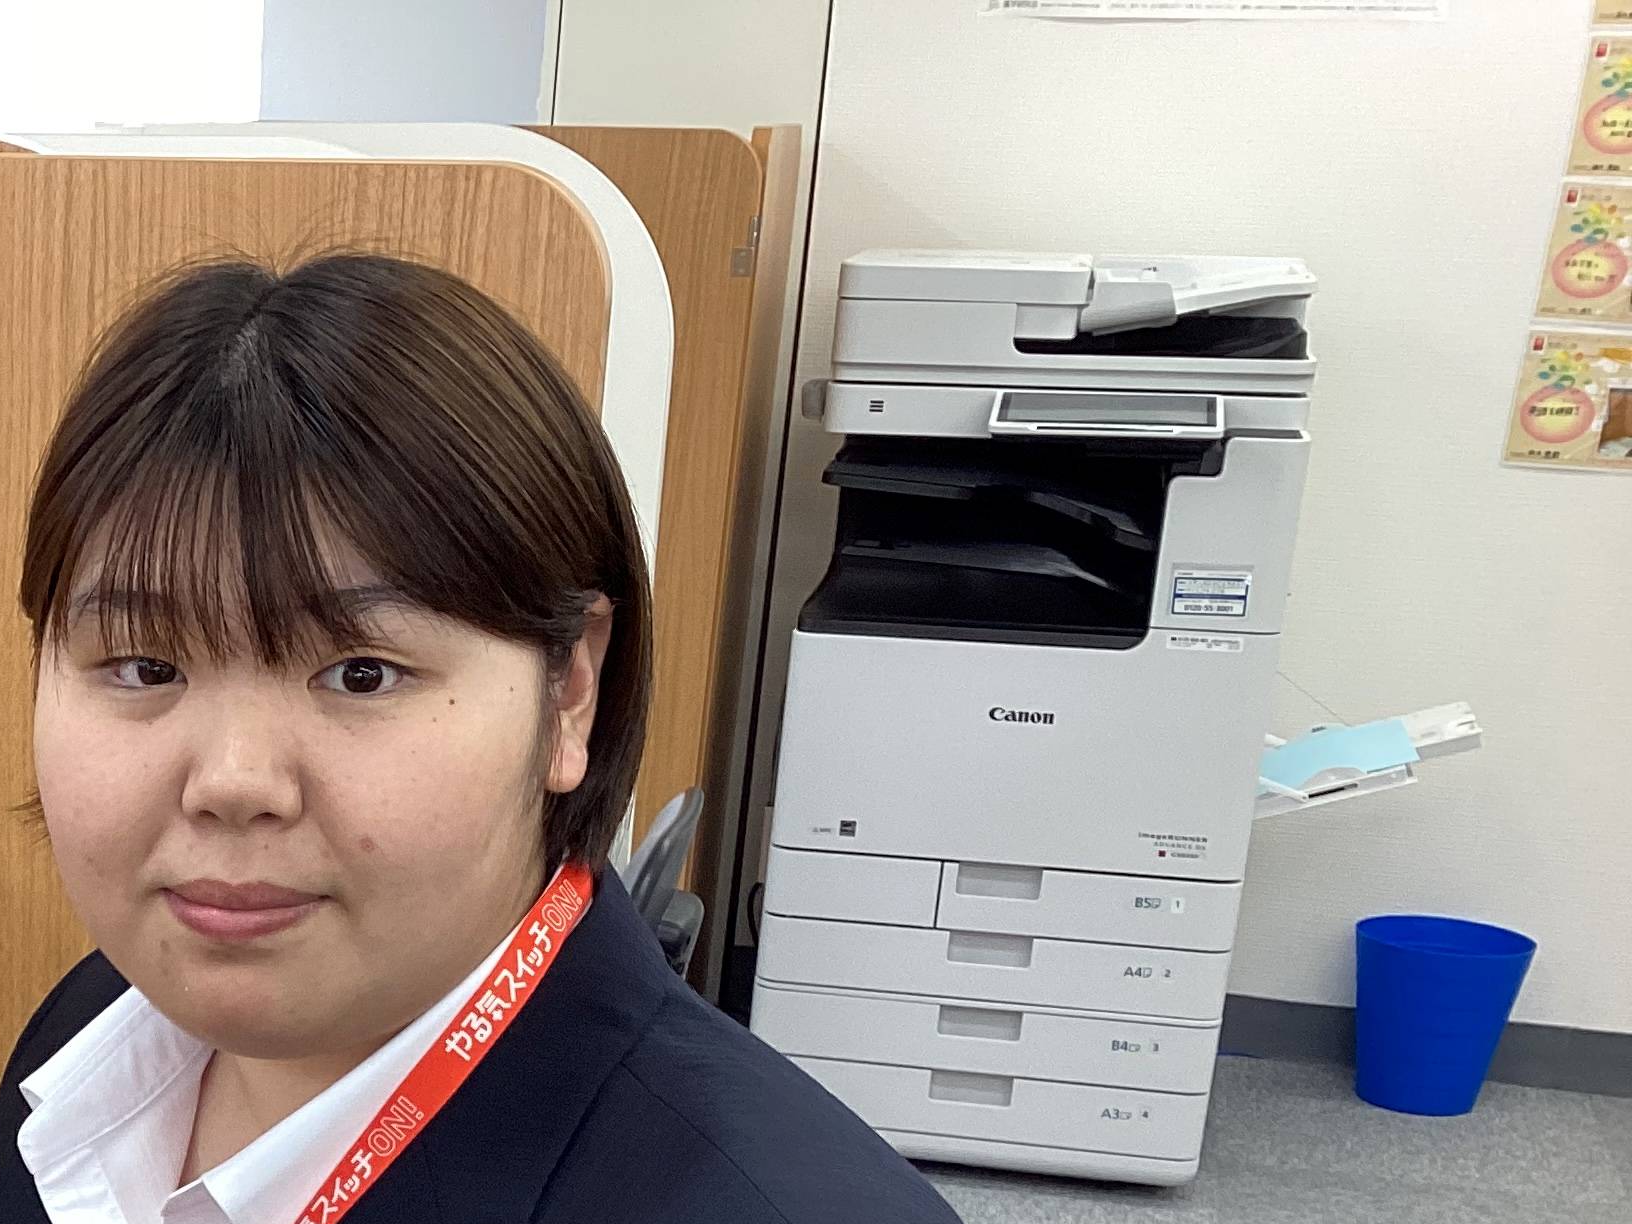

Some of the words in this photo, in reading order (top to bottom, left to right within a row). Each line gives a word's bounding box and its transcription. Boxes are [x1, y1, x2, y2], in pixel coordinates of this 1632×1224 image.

[989, 707, 1055, 725] Canon
[1134, 896, 1152, 909] B5
[1124, 966, 1142, 977] A4
[1111, 1040, 1128, 1051] B4
[1101, 1108, 1120, 1119] A3
